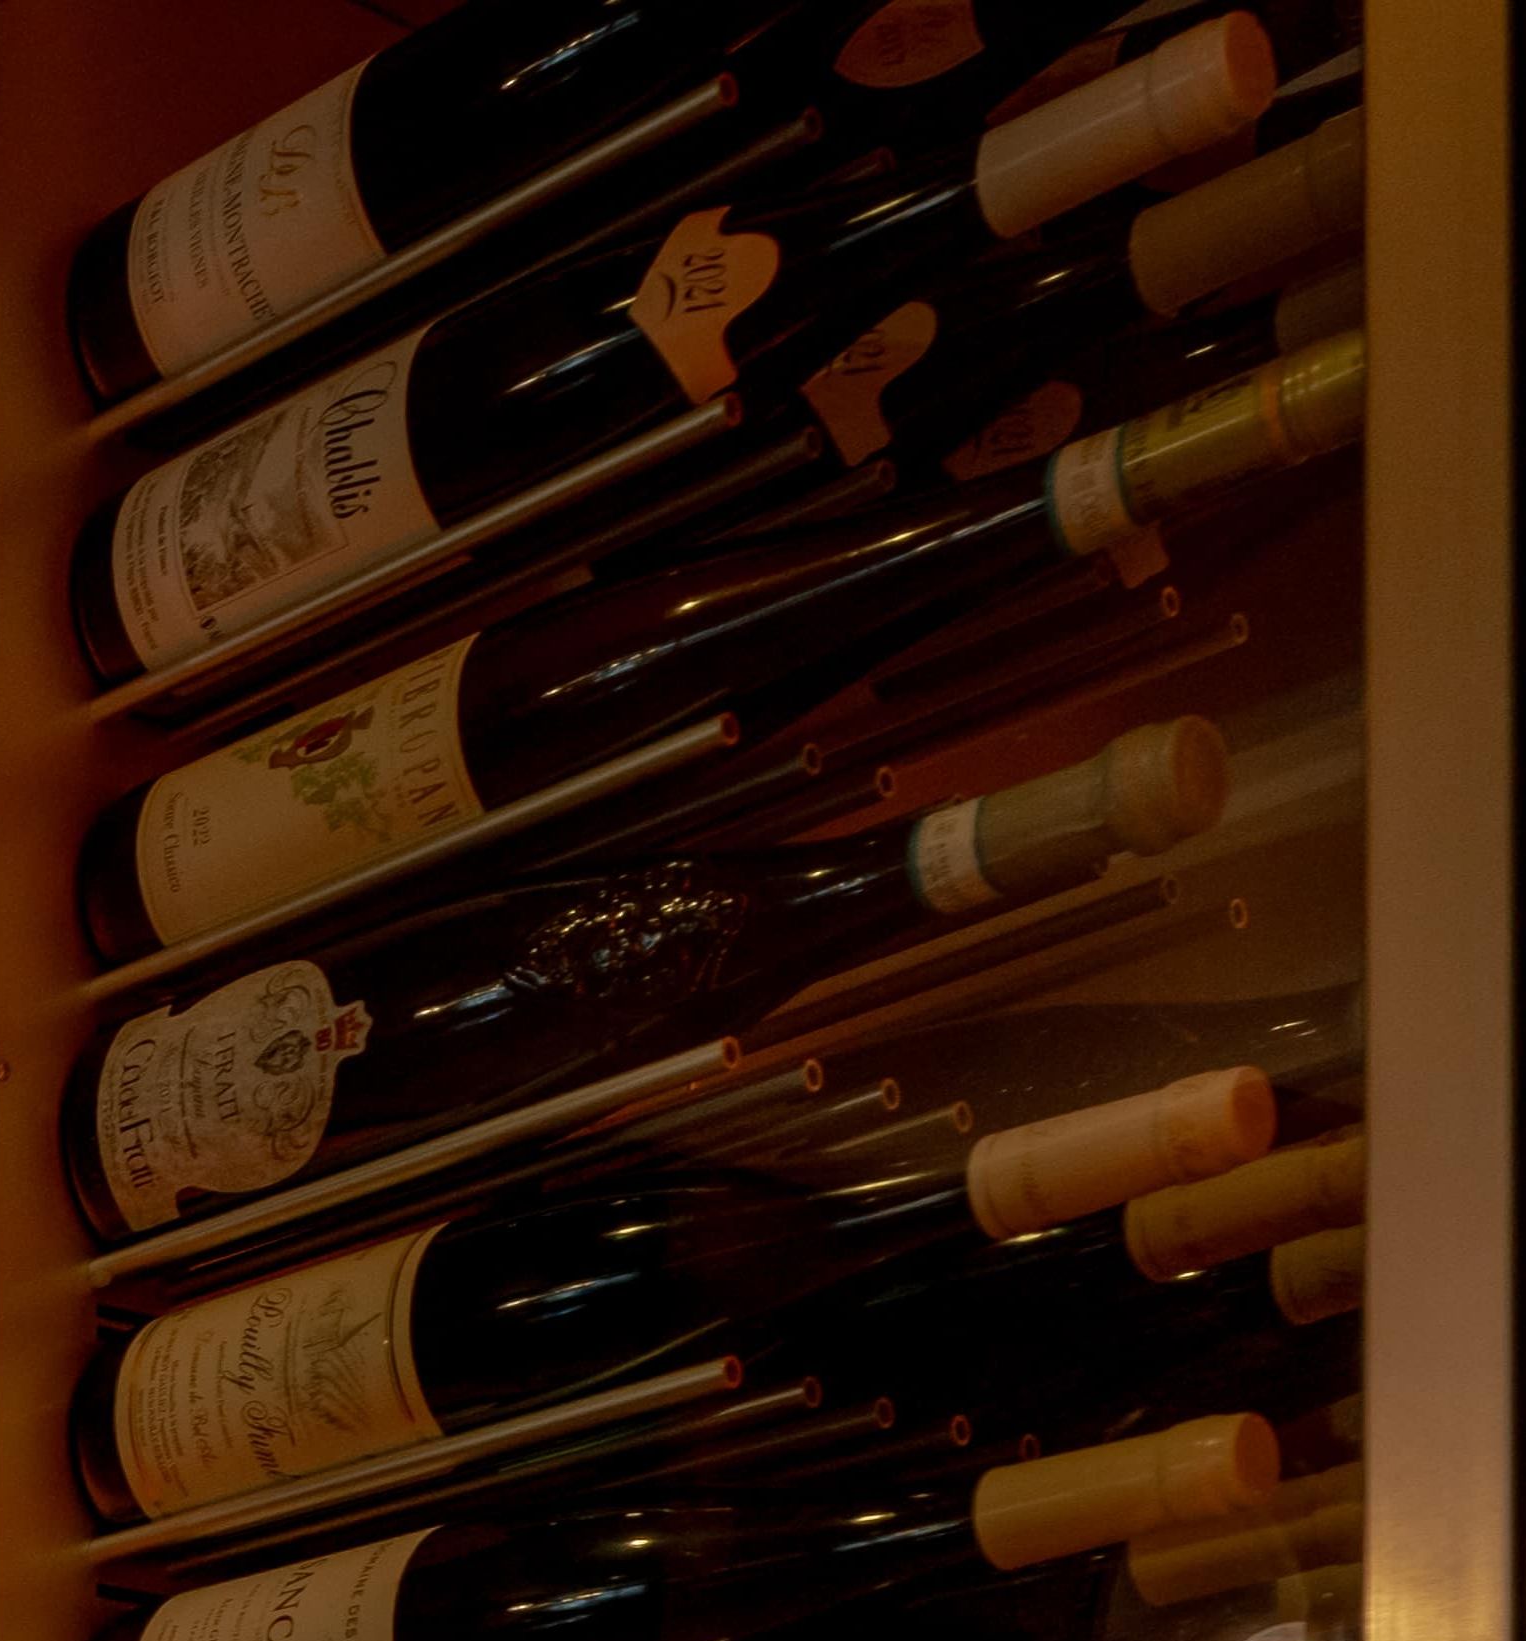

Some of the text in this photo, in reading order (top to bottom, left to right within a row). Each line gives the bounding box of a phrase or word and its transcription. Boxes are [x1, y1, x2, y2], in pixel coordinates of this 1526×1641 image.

[684, 247, 725, 313] 2021
[318, 362, 397, 520] Chablis
[162, 833, 184, 894] Classico
[214, 1047, 243, 1122] FRATI
[226, 1286, 292, 1393] Pouilly
[346, 1605, 361, 1639] DES
